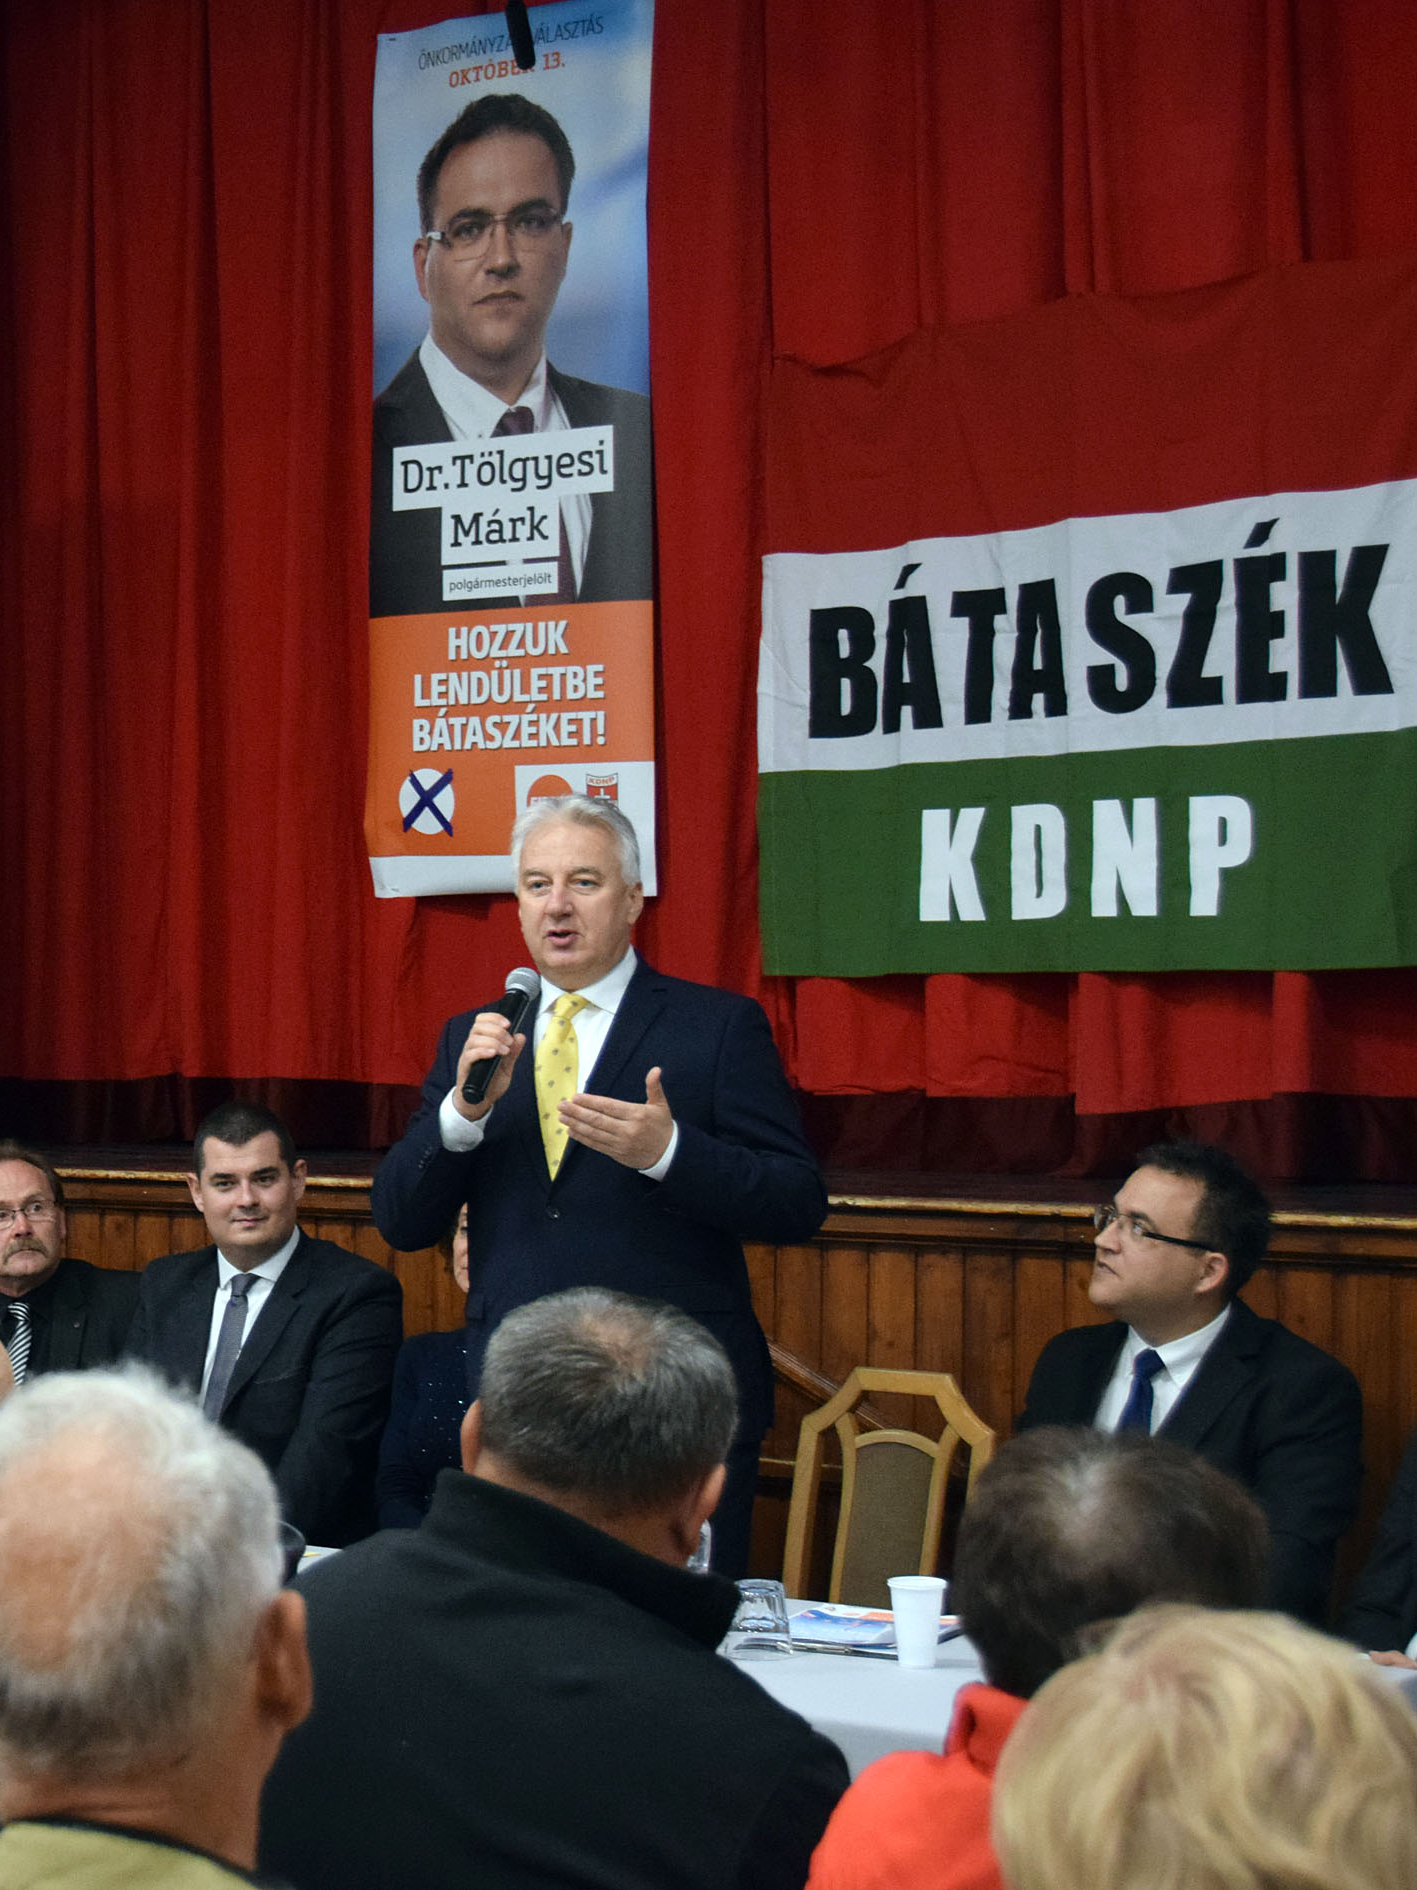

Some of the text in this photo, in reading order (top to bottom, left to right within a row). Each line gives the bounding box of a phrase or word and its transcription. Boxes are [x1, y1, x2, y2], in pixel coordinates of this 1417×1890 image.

[418, 33, 513, 71] ÖNKORMÁNYZA
[448, 51, 566, 89] OKTÓBE 13.
[449, 505, 549, 548] Márk
[448, 572, 553, 594] polgármesterjelölt
[447, 619, 570, 662] HOZZUK
[808, 517, 1395, 740] BÁTASZÉK
[413, 660, 606, 708] LENDÜLETBE
[412, 703, 607, 753] BÁTASZÉKET!
[919, 794, 1254, 923] KDNP
